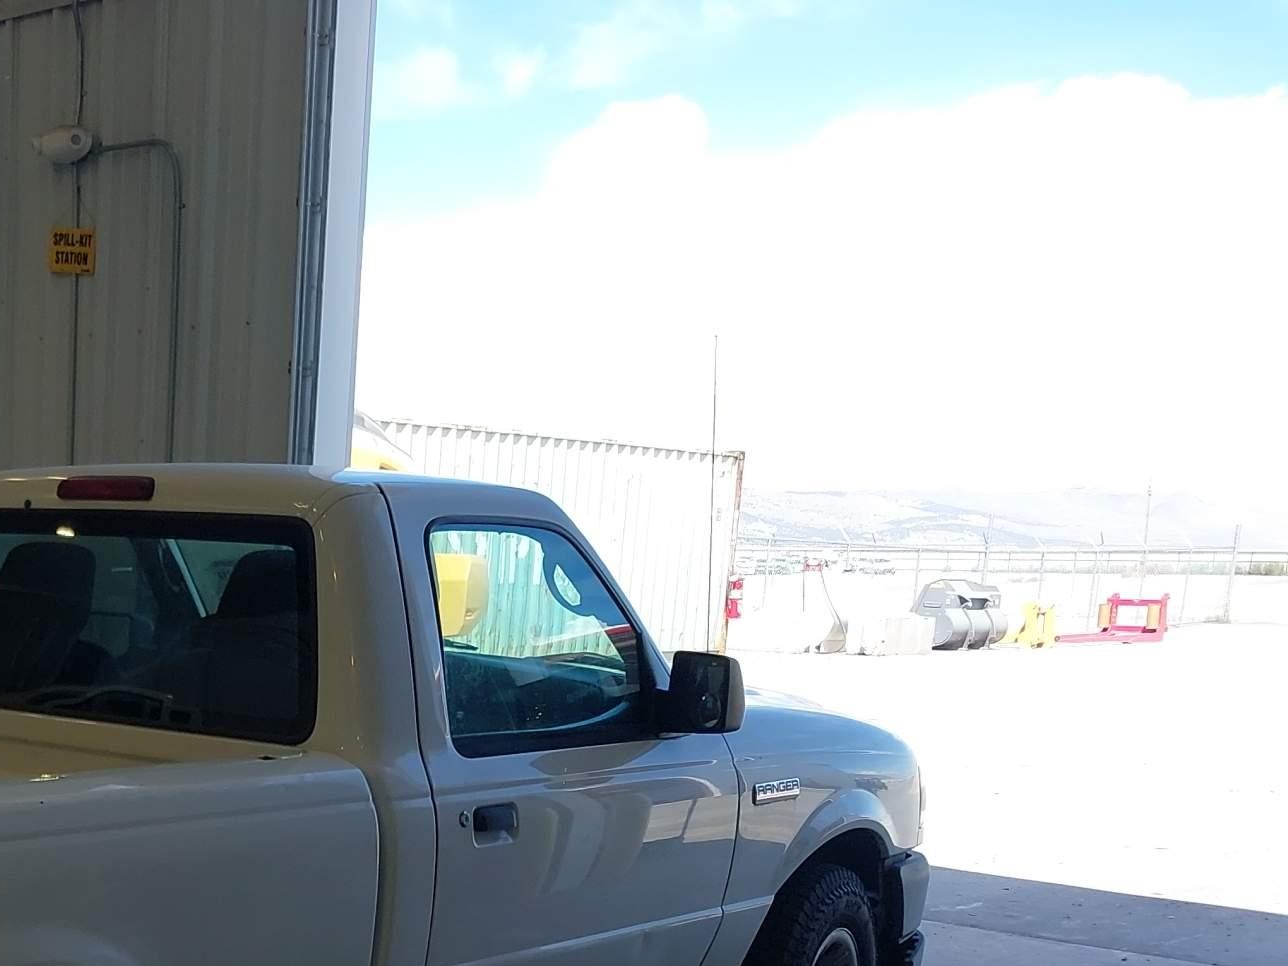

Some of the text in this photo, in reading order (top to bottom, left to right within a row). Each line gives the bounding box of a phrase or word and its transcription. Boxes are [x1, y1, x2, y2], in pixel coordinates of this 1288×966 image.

[53, 231, 92, 248] SPILL-KIT
[55, 250, 88, 266] STATION
[757, 779, 799, 796] RANGER
